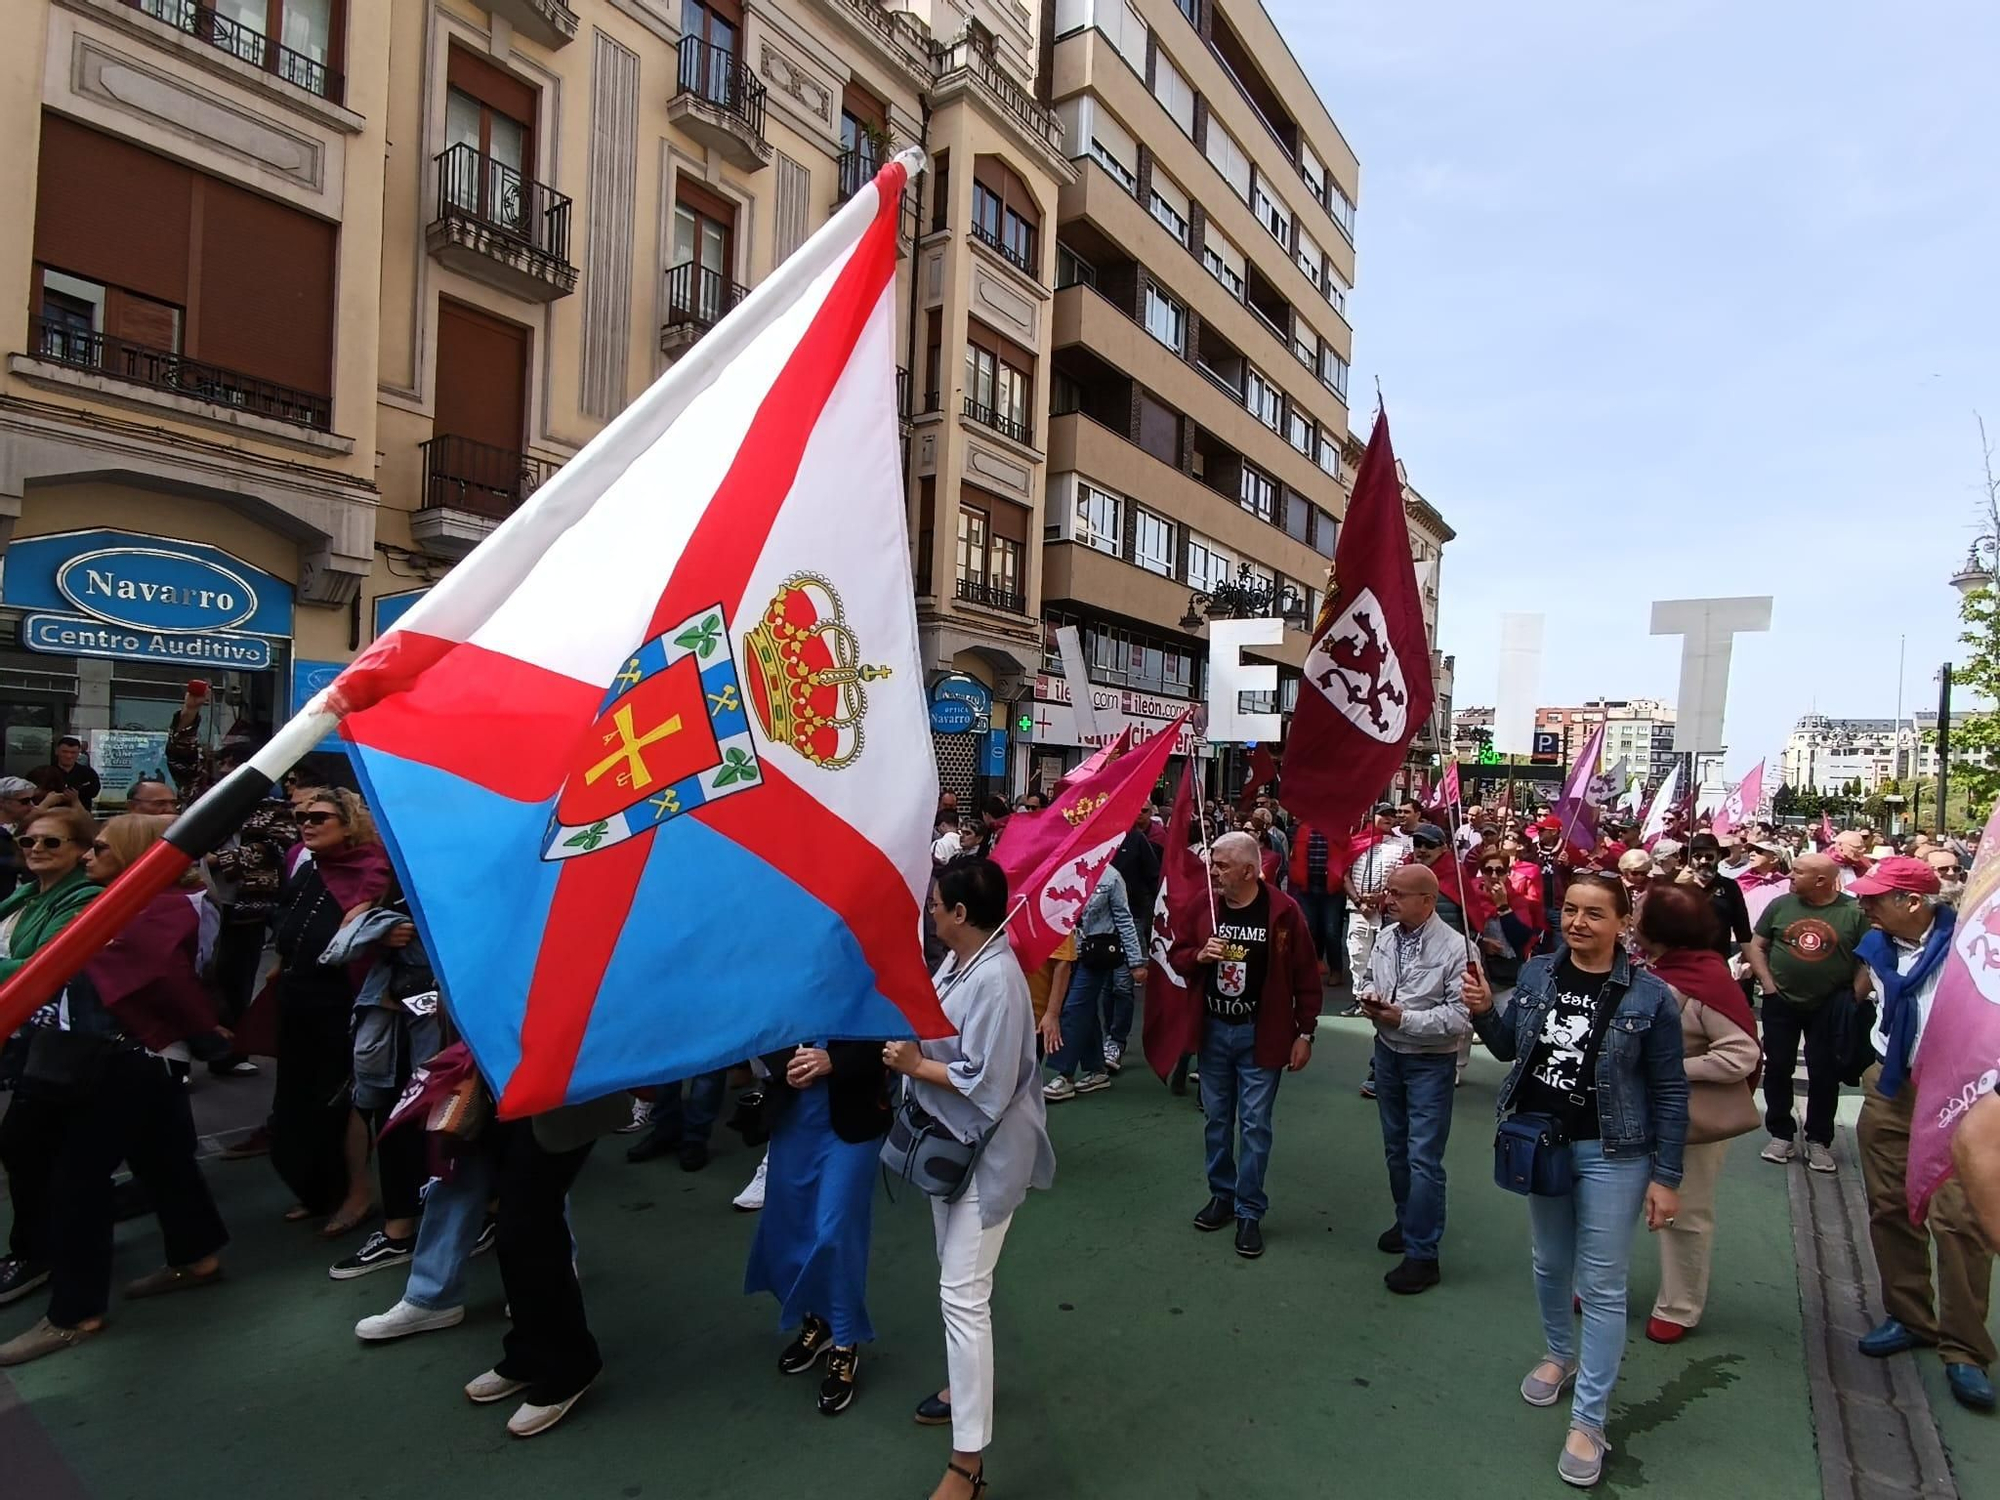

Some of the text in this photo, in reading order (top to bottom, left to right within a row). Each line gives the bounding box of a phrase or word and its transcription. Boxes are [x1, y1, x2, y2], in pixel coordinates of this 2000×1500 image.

[86, 569, 234, 611] Navarro
[40, 625, 261, 661] Centro Auditivo
[931, 712, 970, 724] Navarro
[1537, 735, 1552, 752] P
[1218, 922, 1266, 943] ÉSTAME
